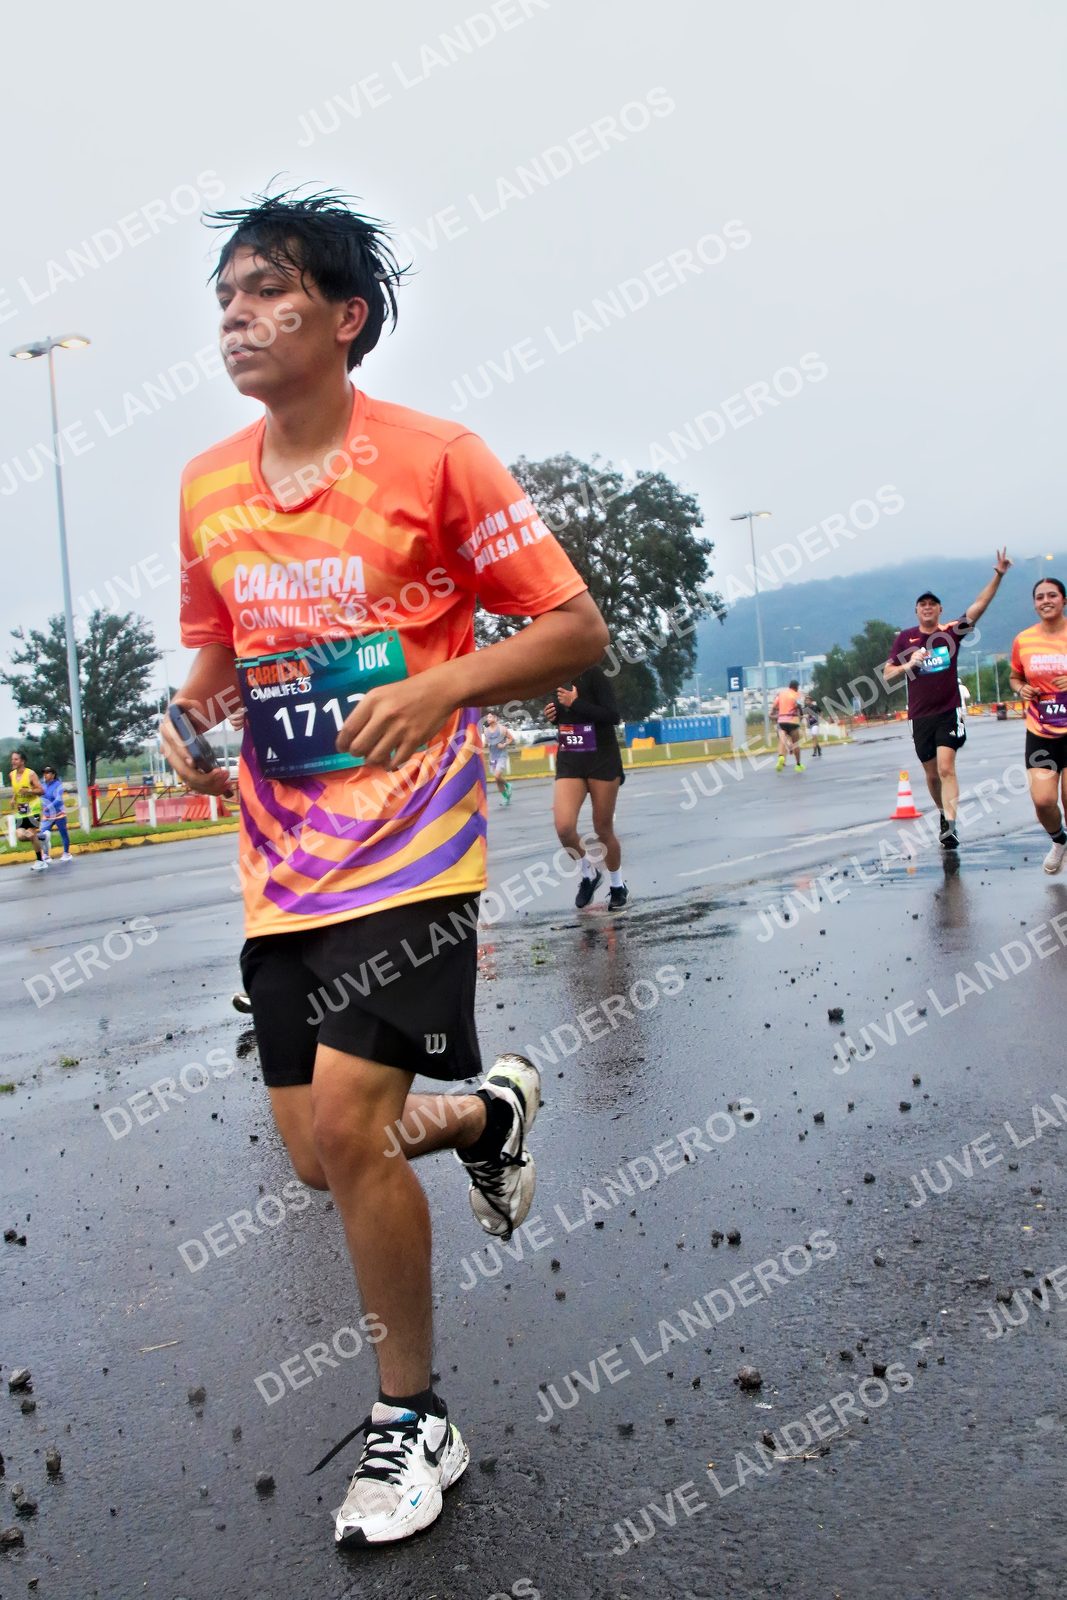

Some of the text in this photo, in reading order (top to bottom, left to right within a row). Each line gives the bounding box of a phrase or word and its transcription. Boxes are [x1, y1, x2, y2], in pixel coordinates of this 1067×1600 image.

[234, 555, 366, 604] CARRERA
[356, 643, 390, 671] 10K
[730, 677, 740, 690] E
[274, 693, 366, 740] 171
[566, 735, 584, 745] 532
